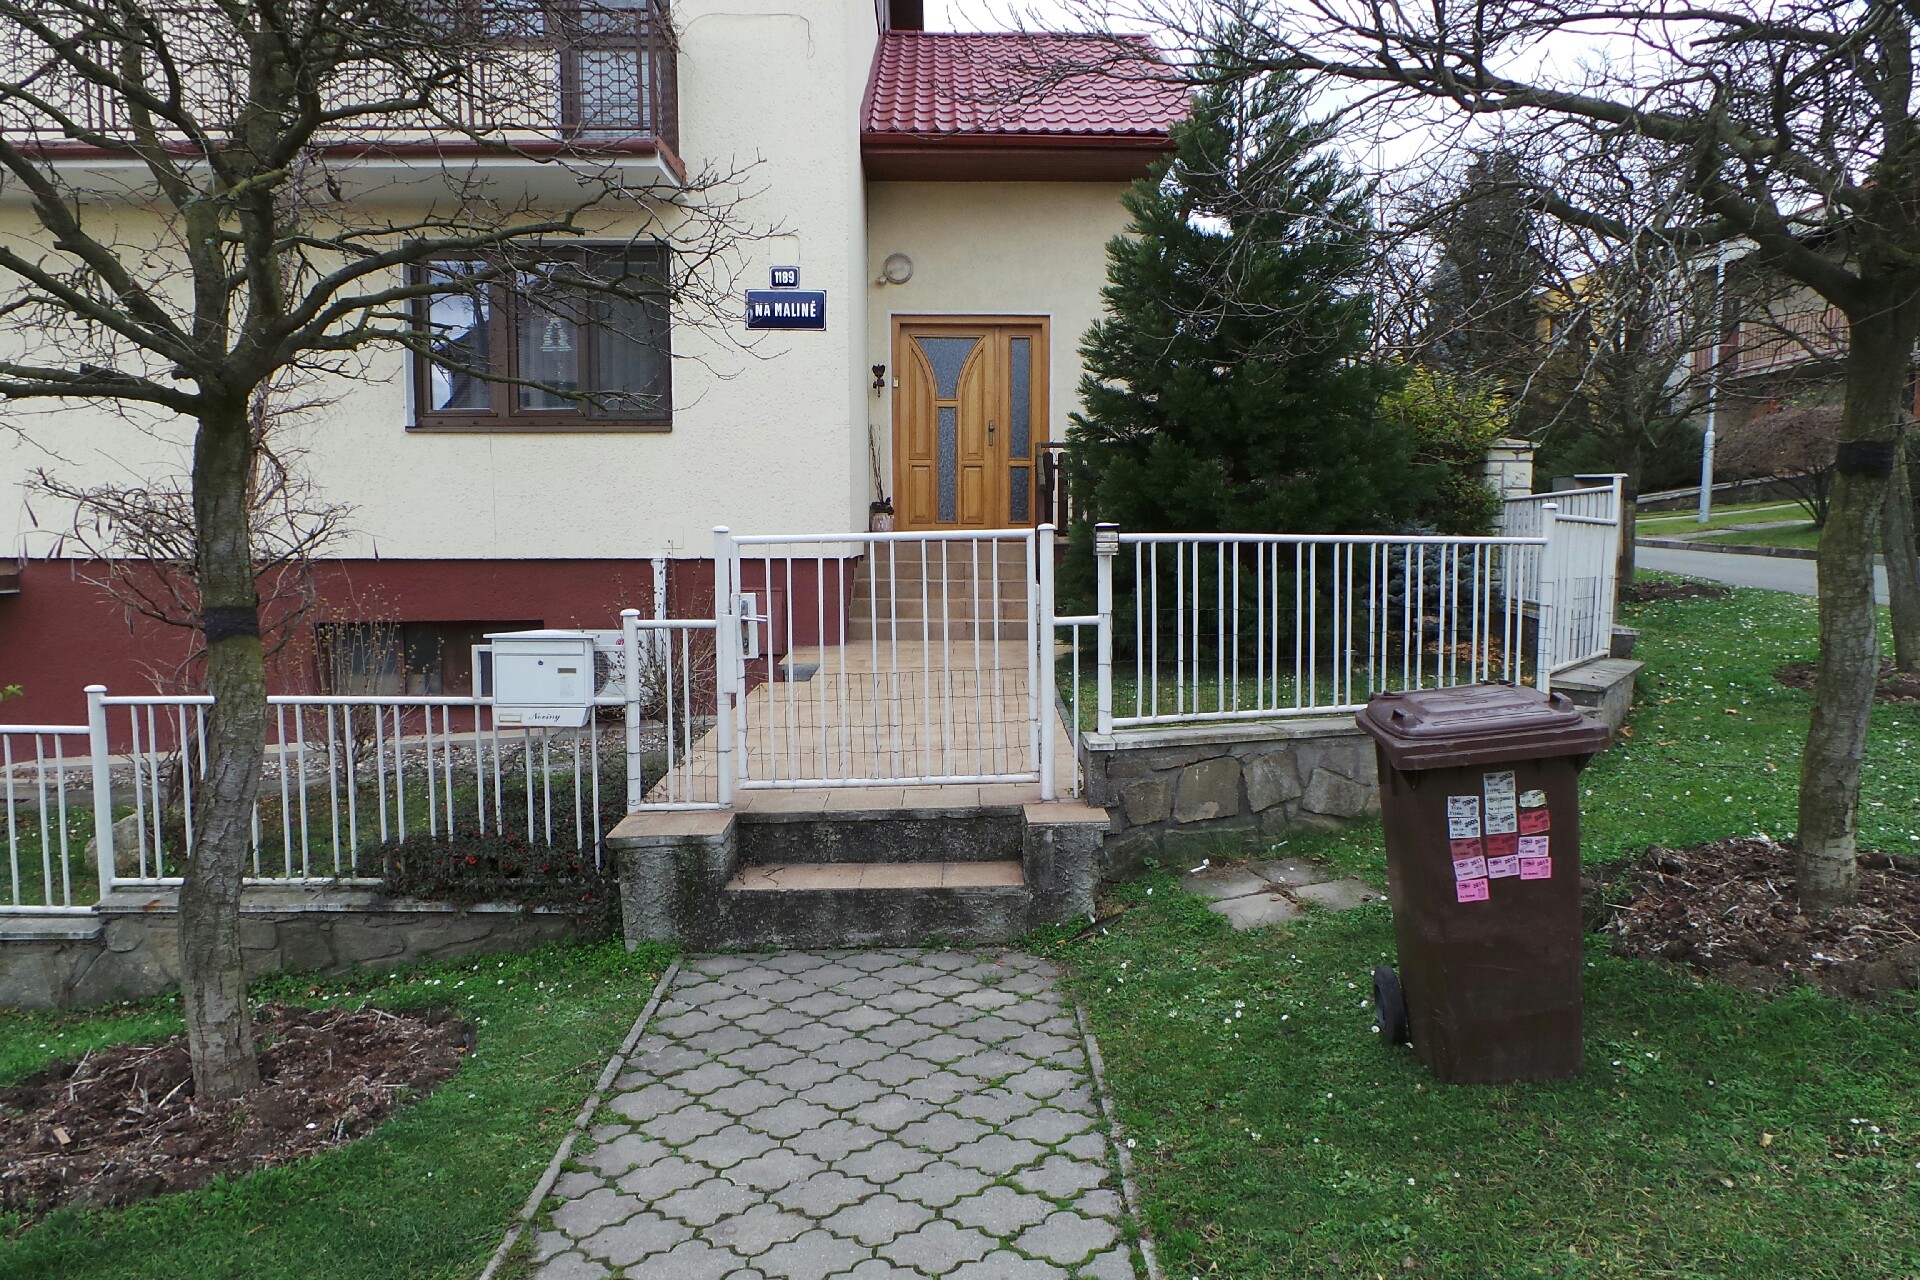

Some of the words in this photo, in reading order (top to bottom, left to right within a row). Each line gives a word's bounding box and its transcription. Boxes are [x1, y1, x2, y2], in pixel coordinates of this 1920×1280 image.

[774, 271, 795, 284] 1189
[755, 302, 771, 317] NA
[774, 300, 817, 318] MALINĚ
